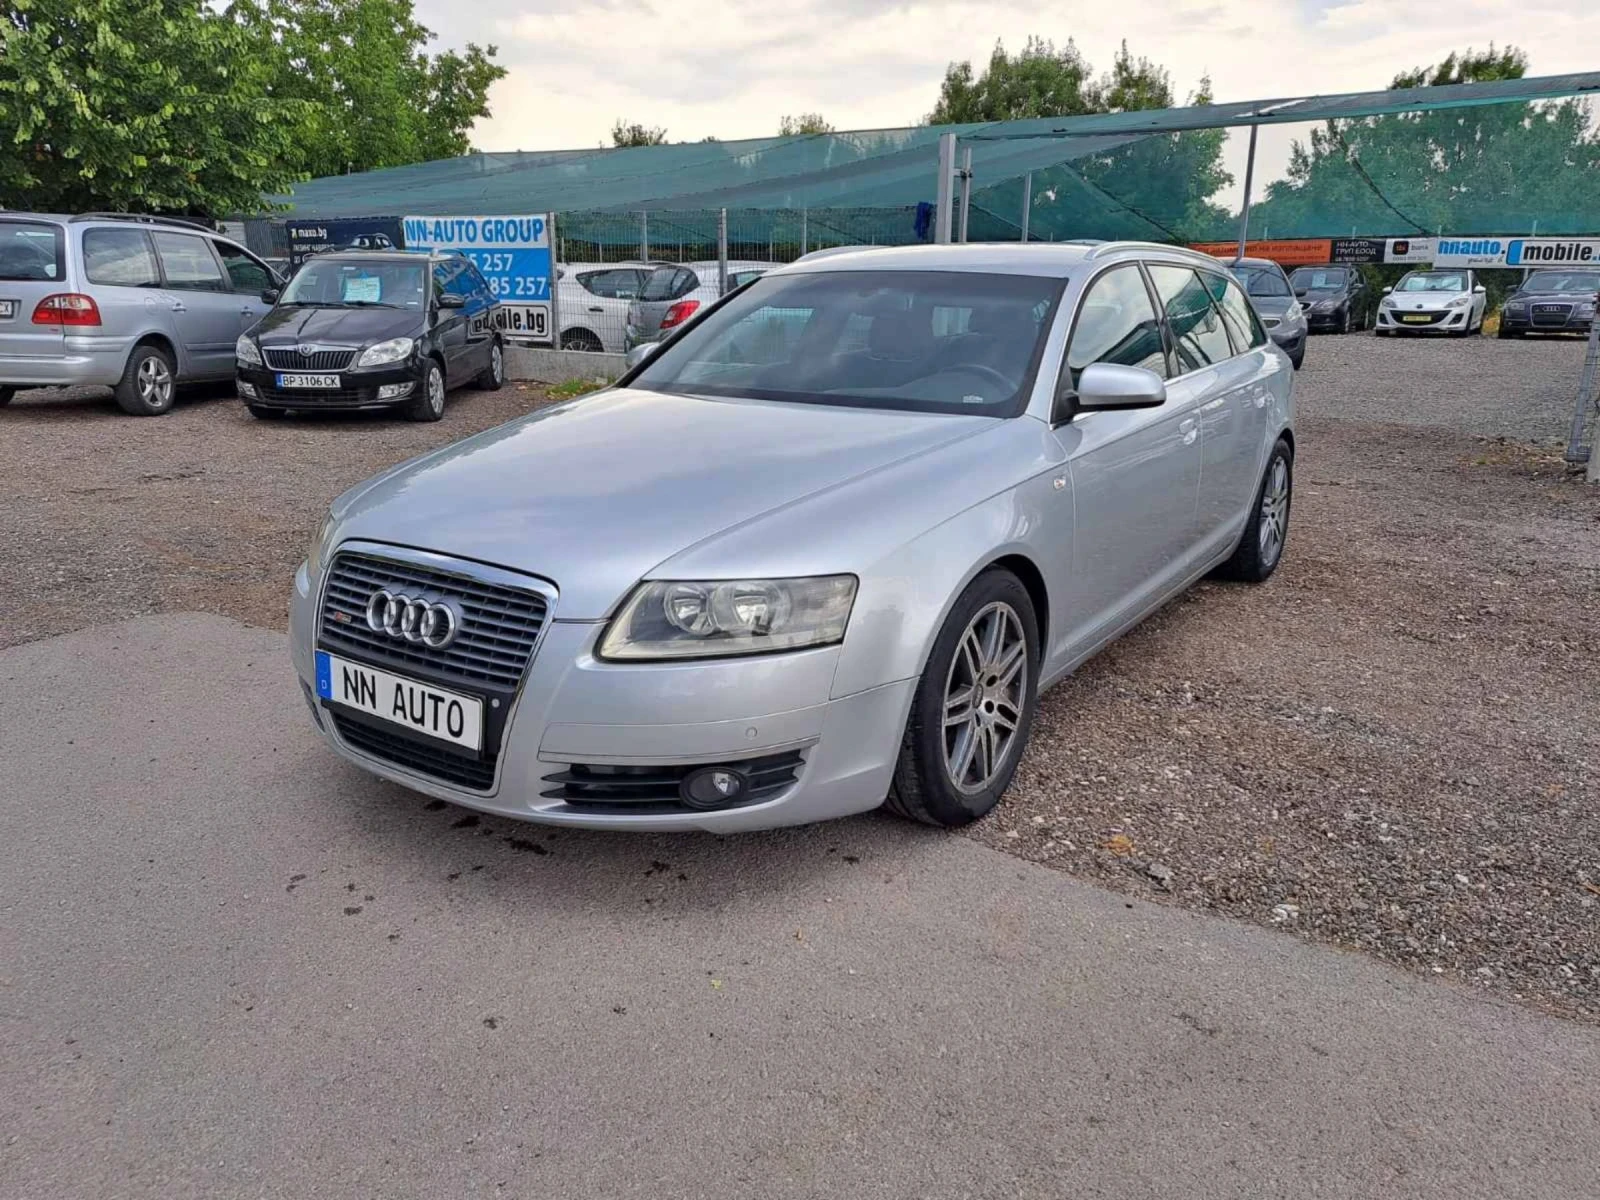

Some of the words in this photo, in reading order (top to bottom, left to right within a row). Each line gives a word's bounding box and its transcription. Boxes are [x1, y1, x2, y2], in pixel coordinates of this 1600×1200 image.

[405, 219, 477, 242] NN-AUTO
[482, 218, 544, 242] GROUP
[1523, 243, 1600, 260] mobile.
[482, 253, 513, 271] 257
[484, 276, 510, 295] 85
[515, 277, 546, 295] 257
[283, 375, 295, 386] BP
[298, 376, 322, 386] 3106
[324, 376, 338, 386] CK
[343, 666, 376, 710] NN
[392, 683, 464, 738] AUTO
